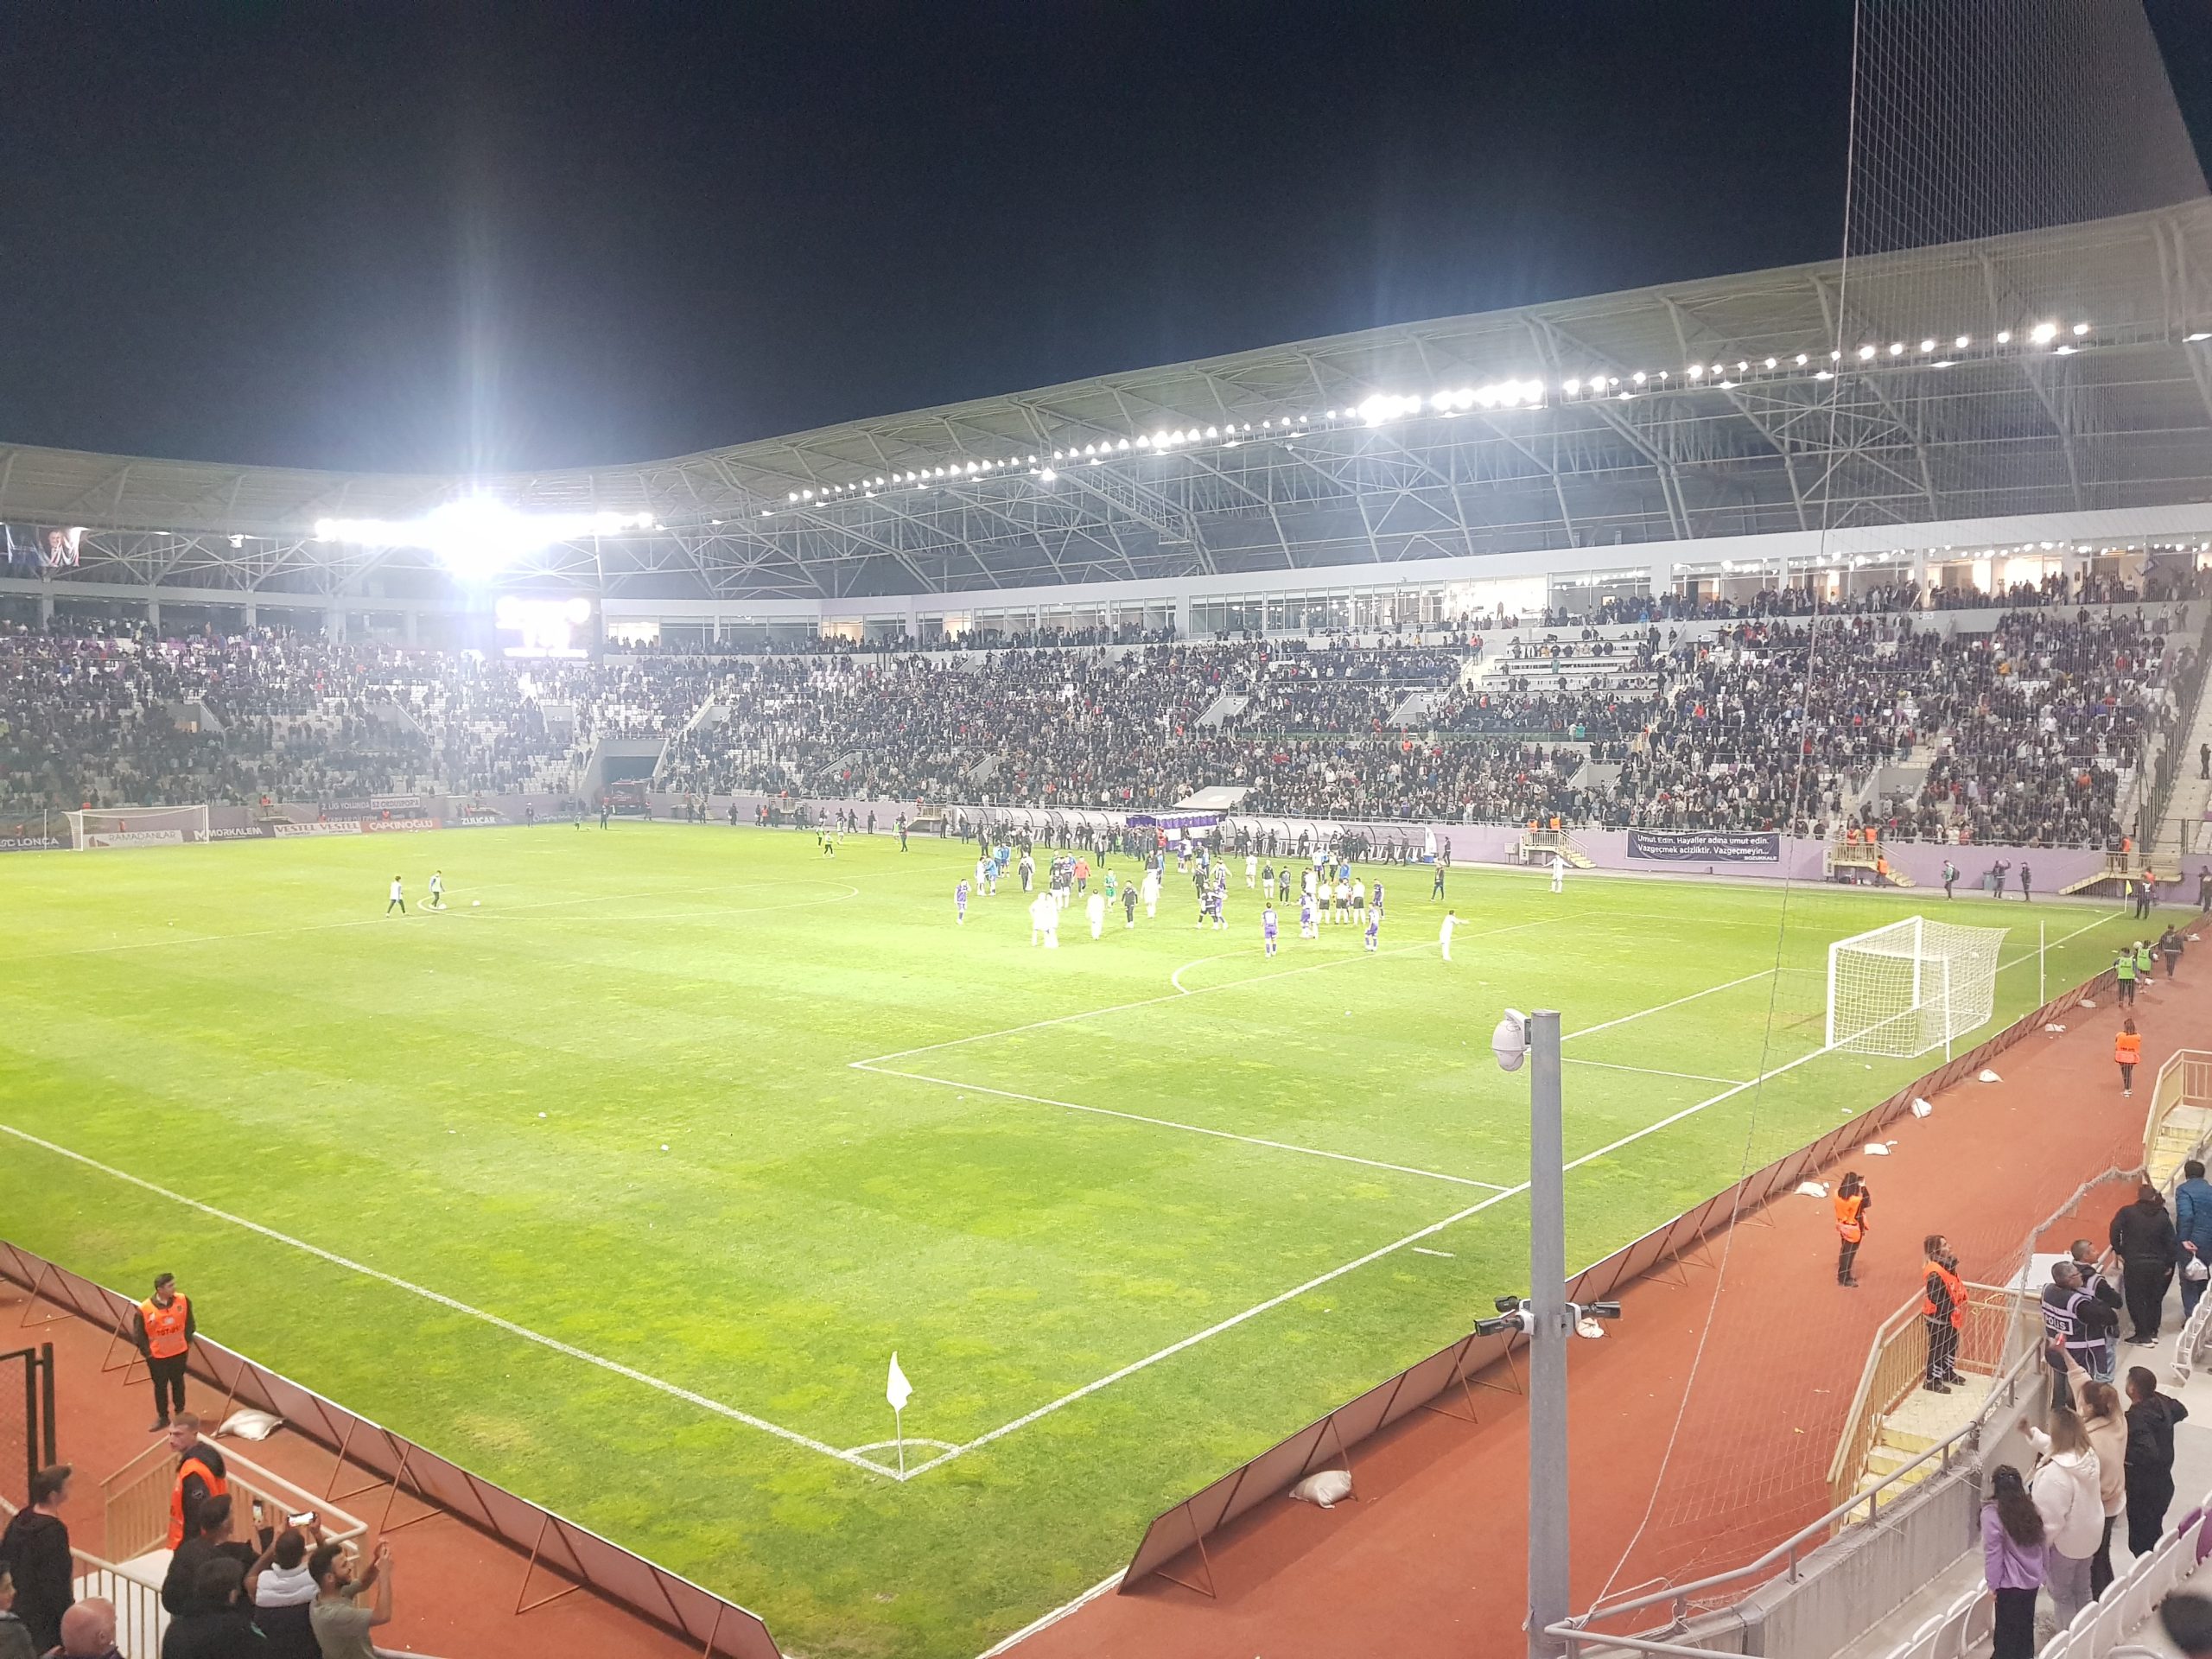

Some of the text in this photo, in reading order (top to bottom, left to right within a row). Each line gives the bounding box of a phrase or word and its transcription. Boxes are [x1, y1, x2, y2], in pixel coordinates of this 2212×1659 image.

[275, 824, 315, 833] VESTEL
[319, 822, 358, 830] VESTEL
[1677, 836, 1706, 846] Hayaller
[1707, 836, 1727, 844] adına
[1638, 843, 1678, 854] Vazgeçmek
